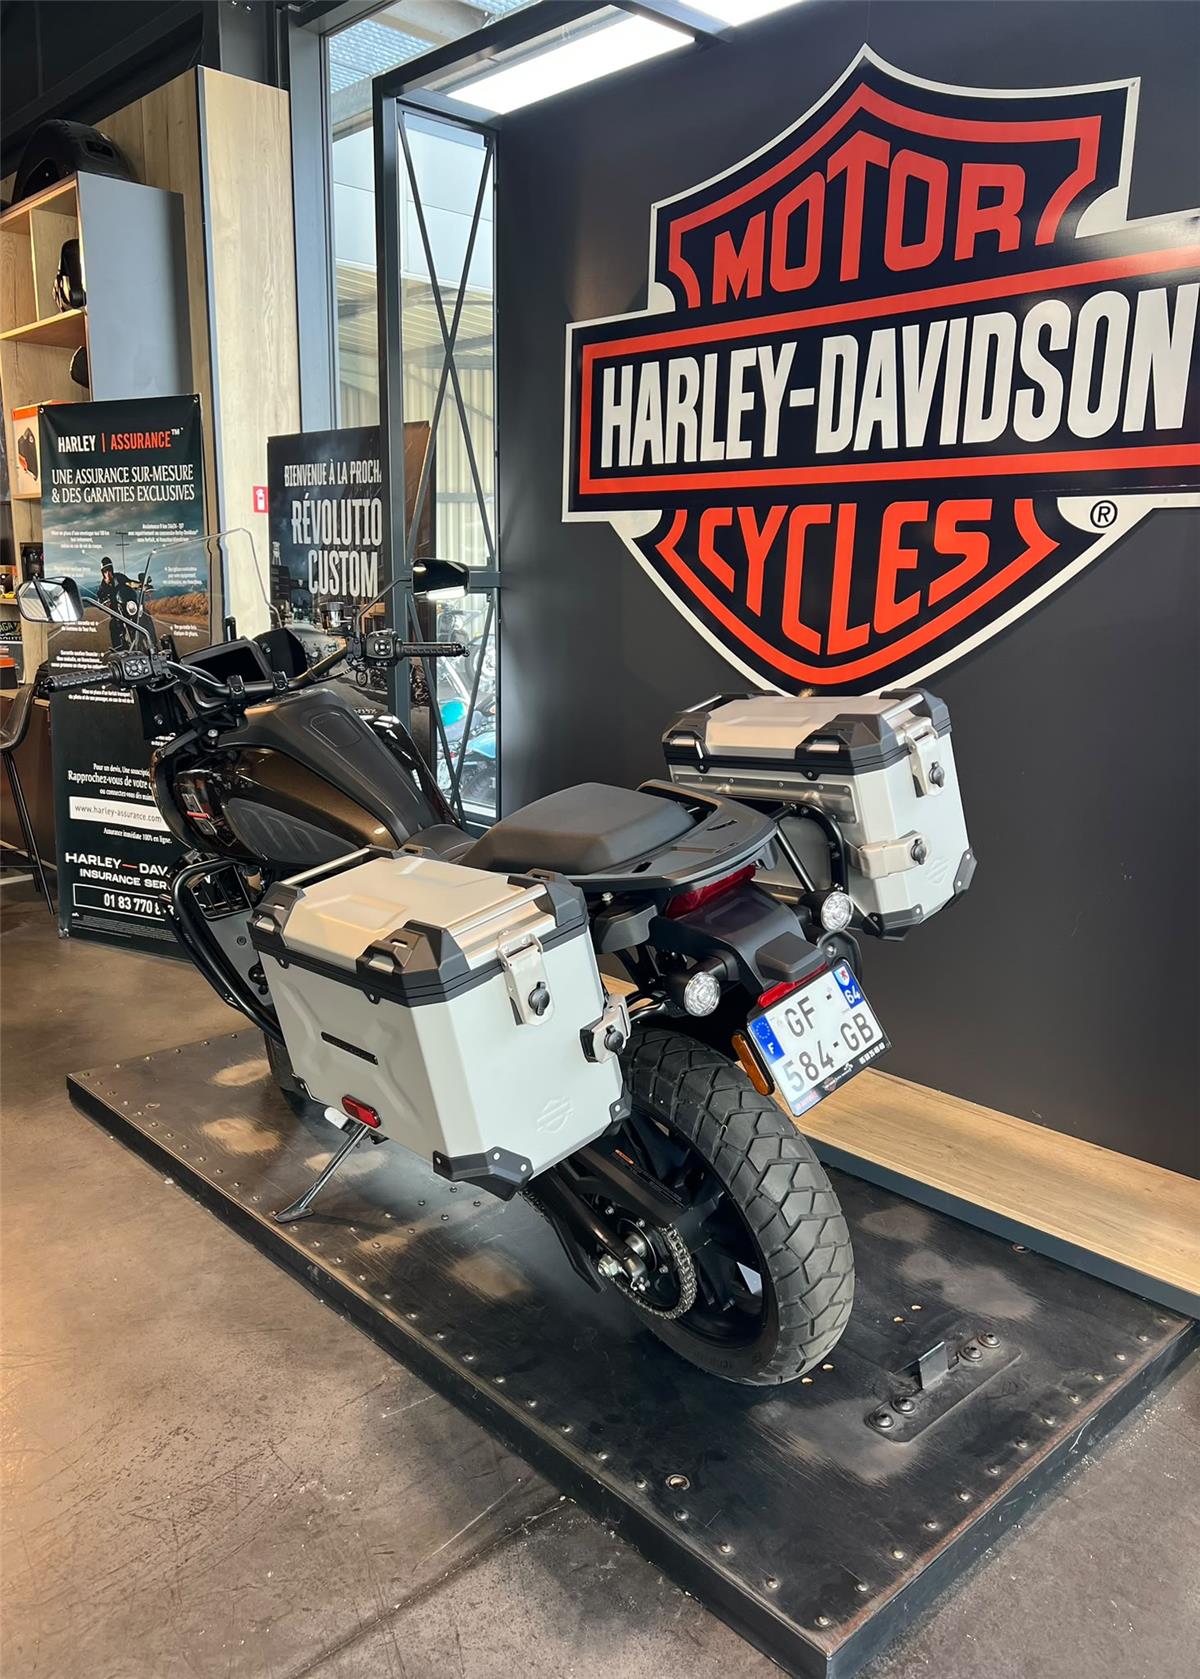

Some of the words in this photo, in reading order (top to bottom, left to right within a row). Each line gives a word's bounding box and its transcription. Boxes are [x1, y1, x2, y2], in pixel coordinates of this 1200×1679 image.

[712, 129, 1026, 303] MOTOR
[599, 282, 1200, 468] HARLEY-DAVIDSON
[58, 435, 96, 453] HARLEY
[51, 469, 73, 485] UNE
[75, 467, 130, 485] ASSURANCE
[131, 464, 194, 482] SUR-MESURE
[284, 463, 327, 487] BIENVENUE
[329, 458, 335, 485] À
[337, 461, 348, 485] LA
[350, 459, 382, 485] PROCH
[51, 487, 60, 503] &
[62, 487, 81, 503] DES
[83, 486, 135, 503] GARANTIES
[137, 484, 195, 502] EXCLUSIVES
[291, 492, 383, 546] RÉVOLUTIO
[308, 549, 379, 598] CUSTOM
[699, 499, 993, 656] CYCLES
[67, 770, 123, 786] Rapprochez-vous
[124, 775, 132, 787] de
[133, 779, 148, 789] votre
[75, 804, 161, 822] www.harley-assurance.com
[80, 868, 141, 887] INSURANCE
[144, 878, 170, 891] SER
[104, 892, 115, 908] 01
[118, 896, 132, 910] 83
[133, 898, 153, 914] 770
[844, 985, 861, 1004] 64
[767, 1042, 775, 1055] F
[782, 1012, 875, 1092] 584-GB
